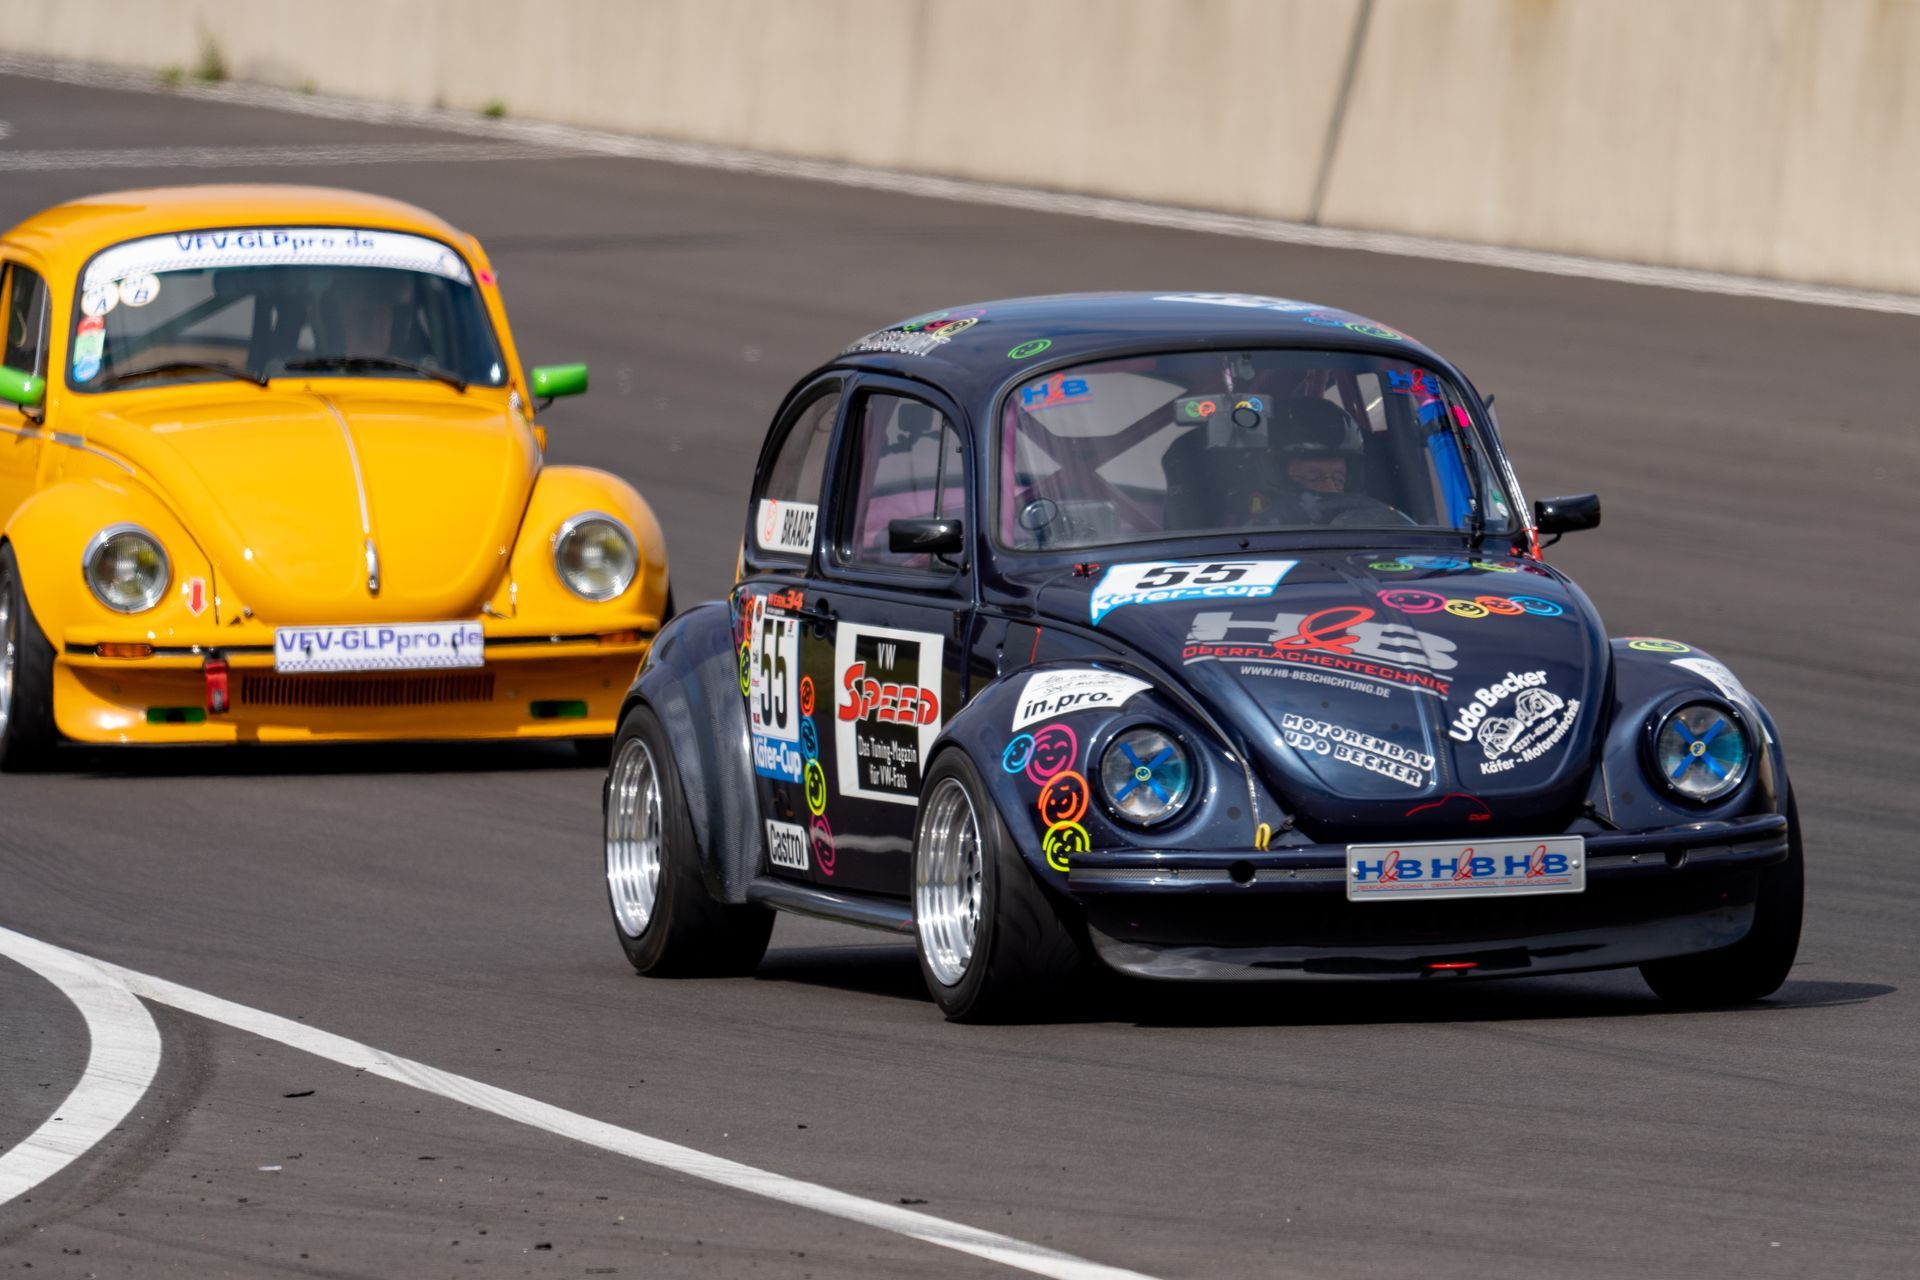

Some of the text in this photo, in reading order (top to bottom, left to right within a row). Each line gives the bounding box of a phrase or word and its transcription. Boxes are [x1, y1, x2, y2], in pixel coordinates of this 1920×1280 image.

[1022, 373, 1089, 404] H&B
[781, 509, 814, 547] BRAADE
[1135, 563, 1259, 590] 55
[279, 625, 483, 655] VFV-GLPpro.de
[877, 642, 896, 671] VW
[1186, 606, 1458, 670] H&B
[761, 618, 787, 729] 55
[1241, 665, 1391, 698] WWW.HB-BESCHICHTUNG.DE
[1023, 691, 1114, 720] in.pro.
[1449, 670, 1547, 742] Udo Becker
[858, 735, 917, 767] Das Tuning-Magazin
[1282, 713, 1435, 771] MOTORENBAU
[1480, 757, 1516, 775] Käfer
[1521, 698, 1581, 762] Motorentechnik
[753, 735, 802, 783] Käfer-Cup
[880, 765, 907, 788] VW-Fans
[1284, 730, 1423, 788] UDO BECKER
[770, 823, 805, 867] Castrol
[1356, 844, 1569, 884] H&B H&B H&B
